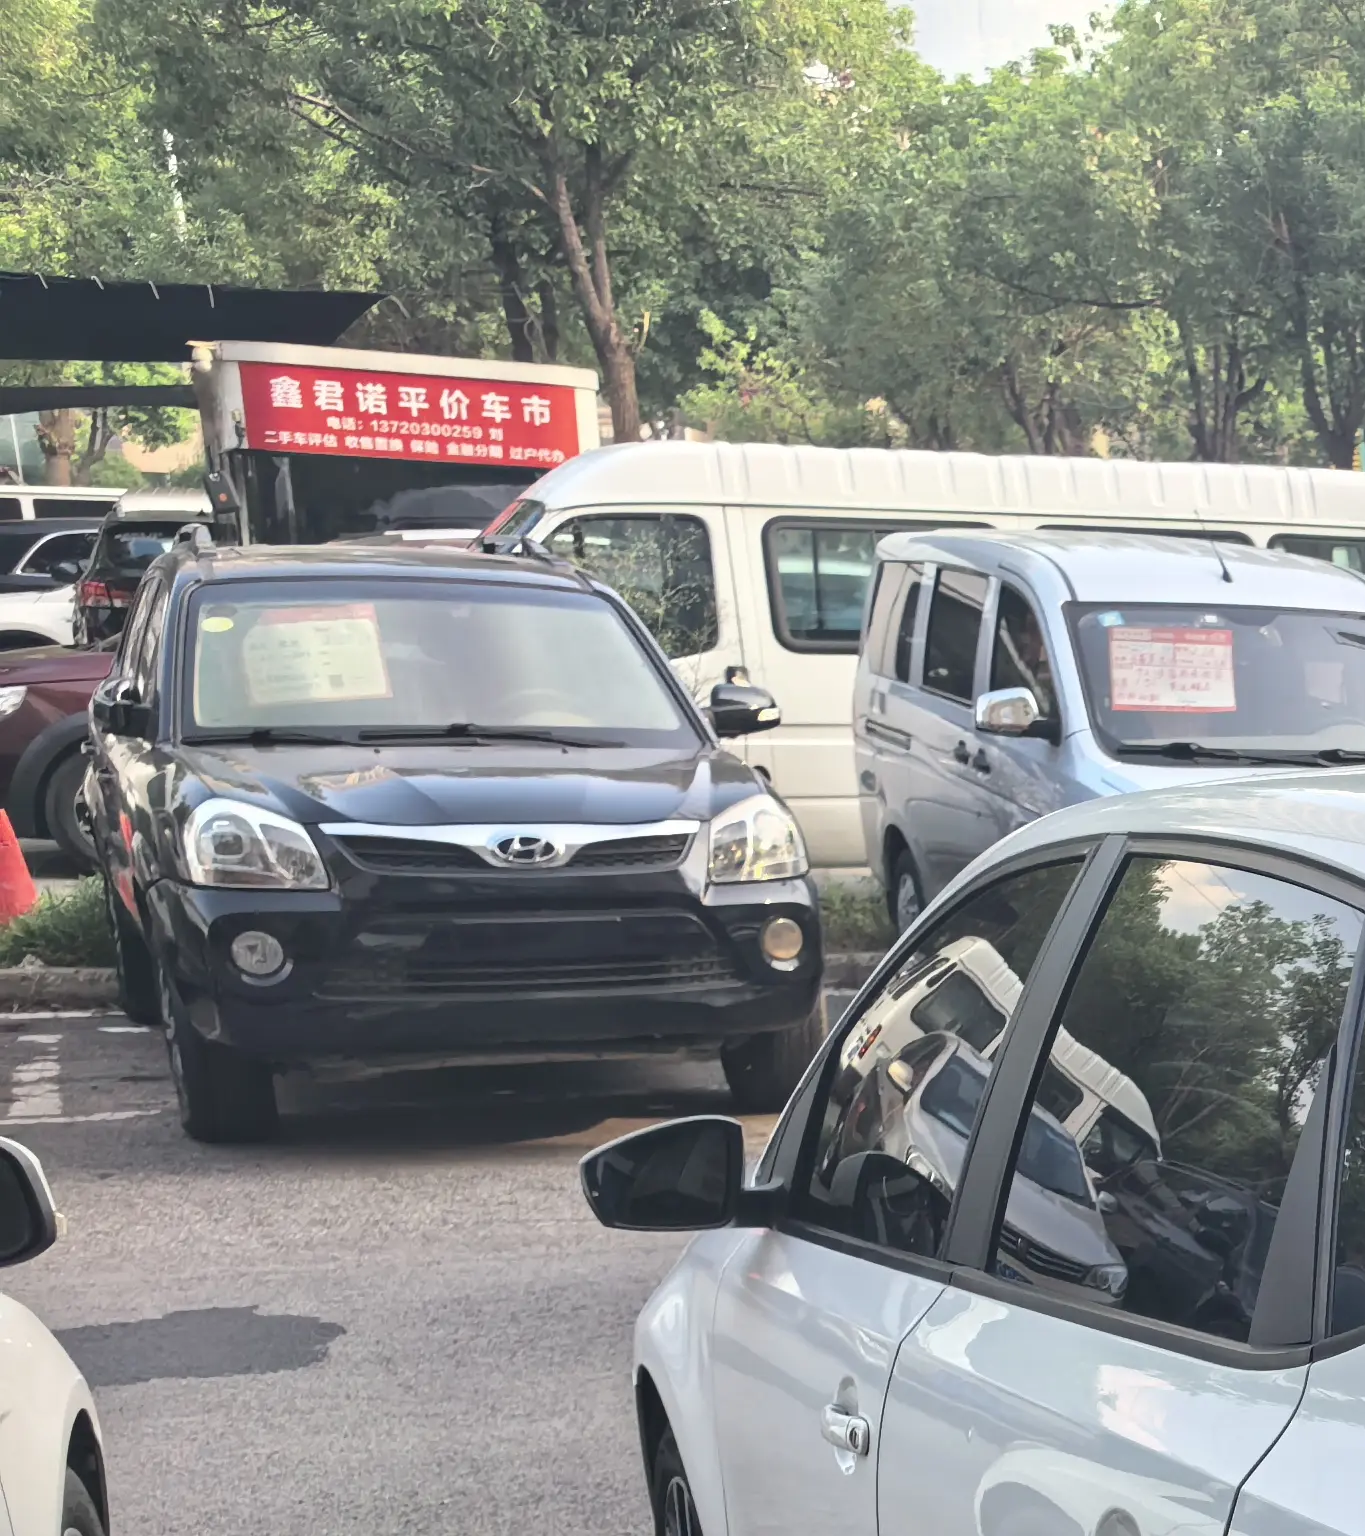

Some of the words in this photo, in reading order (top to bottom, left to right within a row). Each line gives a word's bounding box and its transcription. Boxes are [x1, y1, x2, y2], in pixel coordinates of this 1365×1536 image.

[269, 375, 552, 427] 鑫君诺平价车市
[368, 419, 483, 440] 13720300259
[264, 430, 338, 448] 二手车评估
[509, 446, 566, 464] 过户代办
